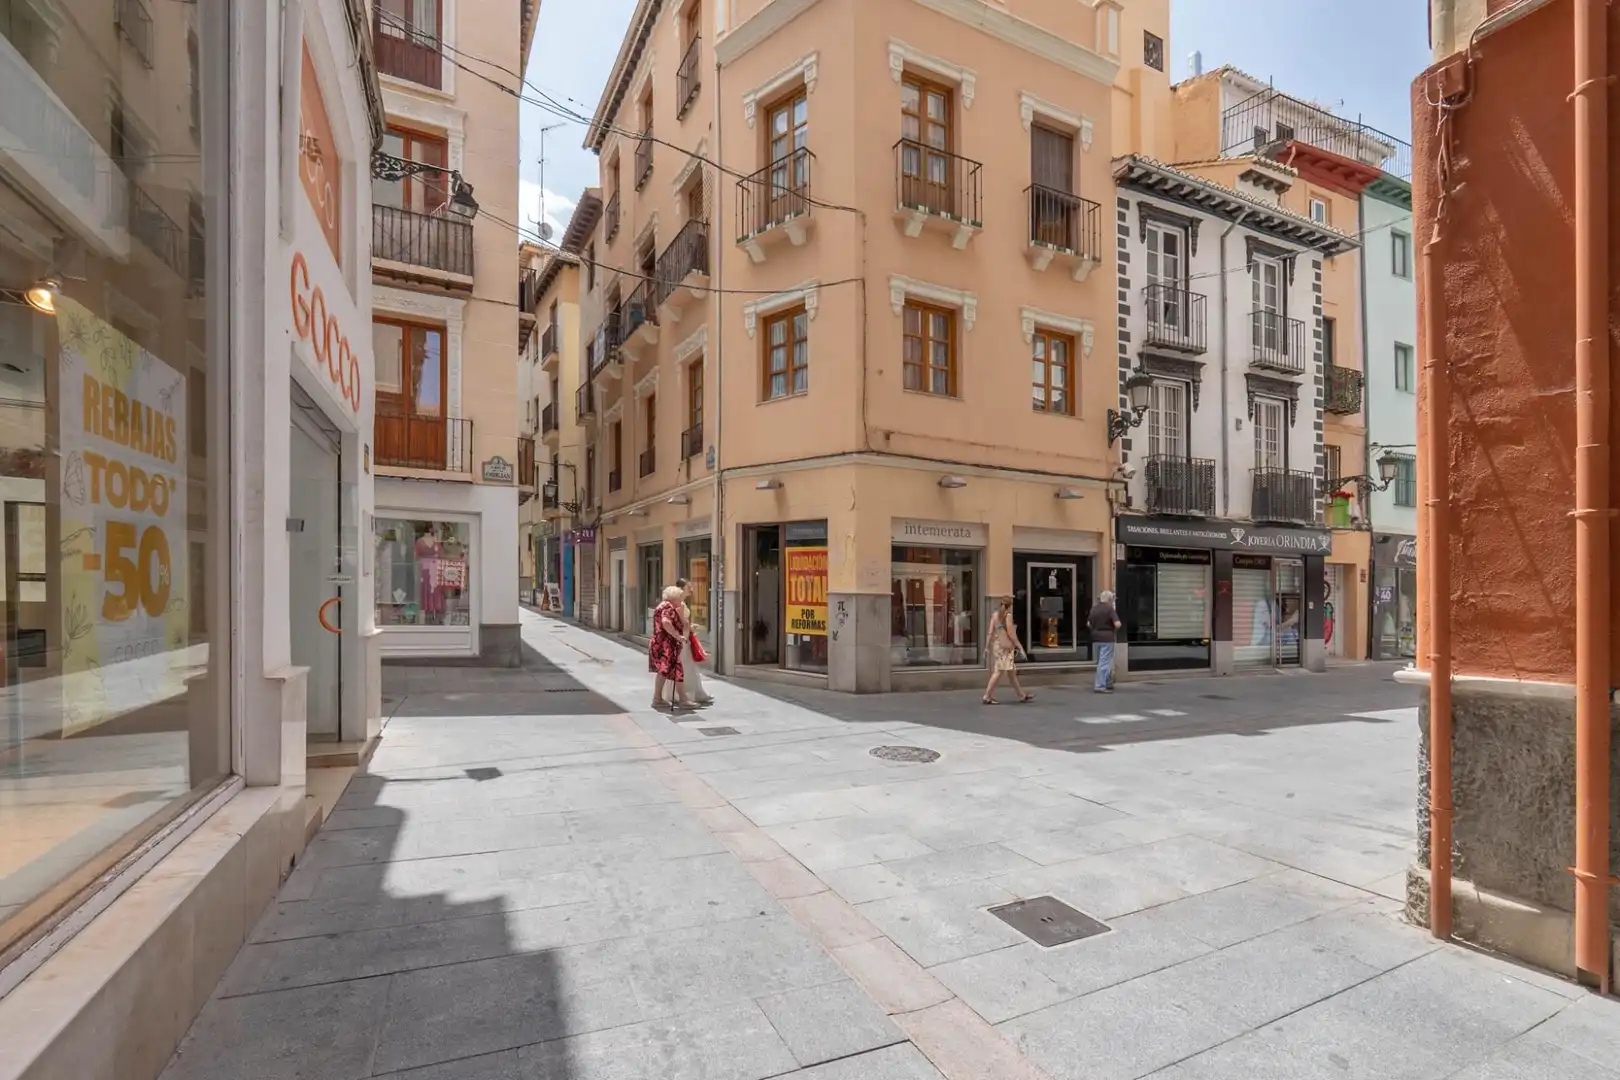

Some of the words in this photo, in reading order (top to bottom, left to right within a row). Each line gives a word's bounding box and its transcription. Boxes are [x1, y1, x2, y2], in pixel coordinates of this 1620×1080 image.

[290, 251, 361, 413] GOCCO
[83, 371, 177, 464] REBAJAS
[904, 521, 972, 538] intemerata
[1276, 534, 1317, 550] ORINDIA
[801, 608, 815, 619] POR
[791, 618, 826, 631] REFORMAS
